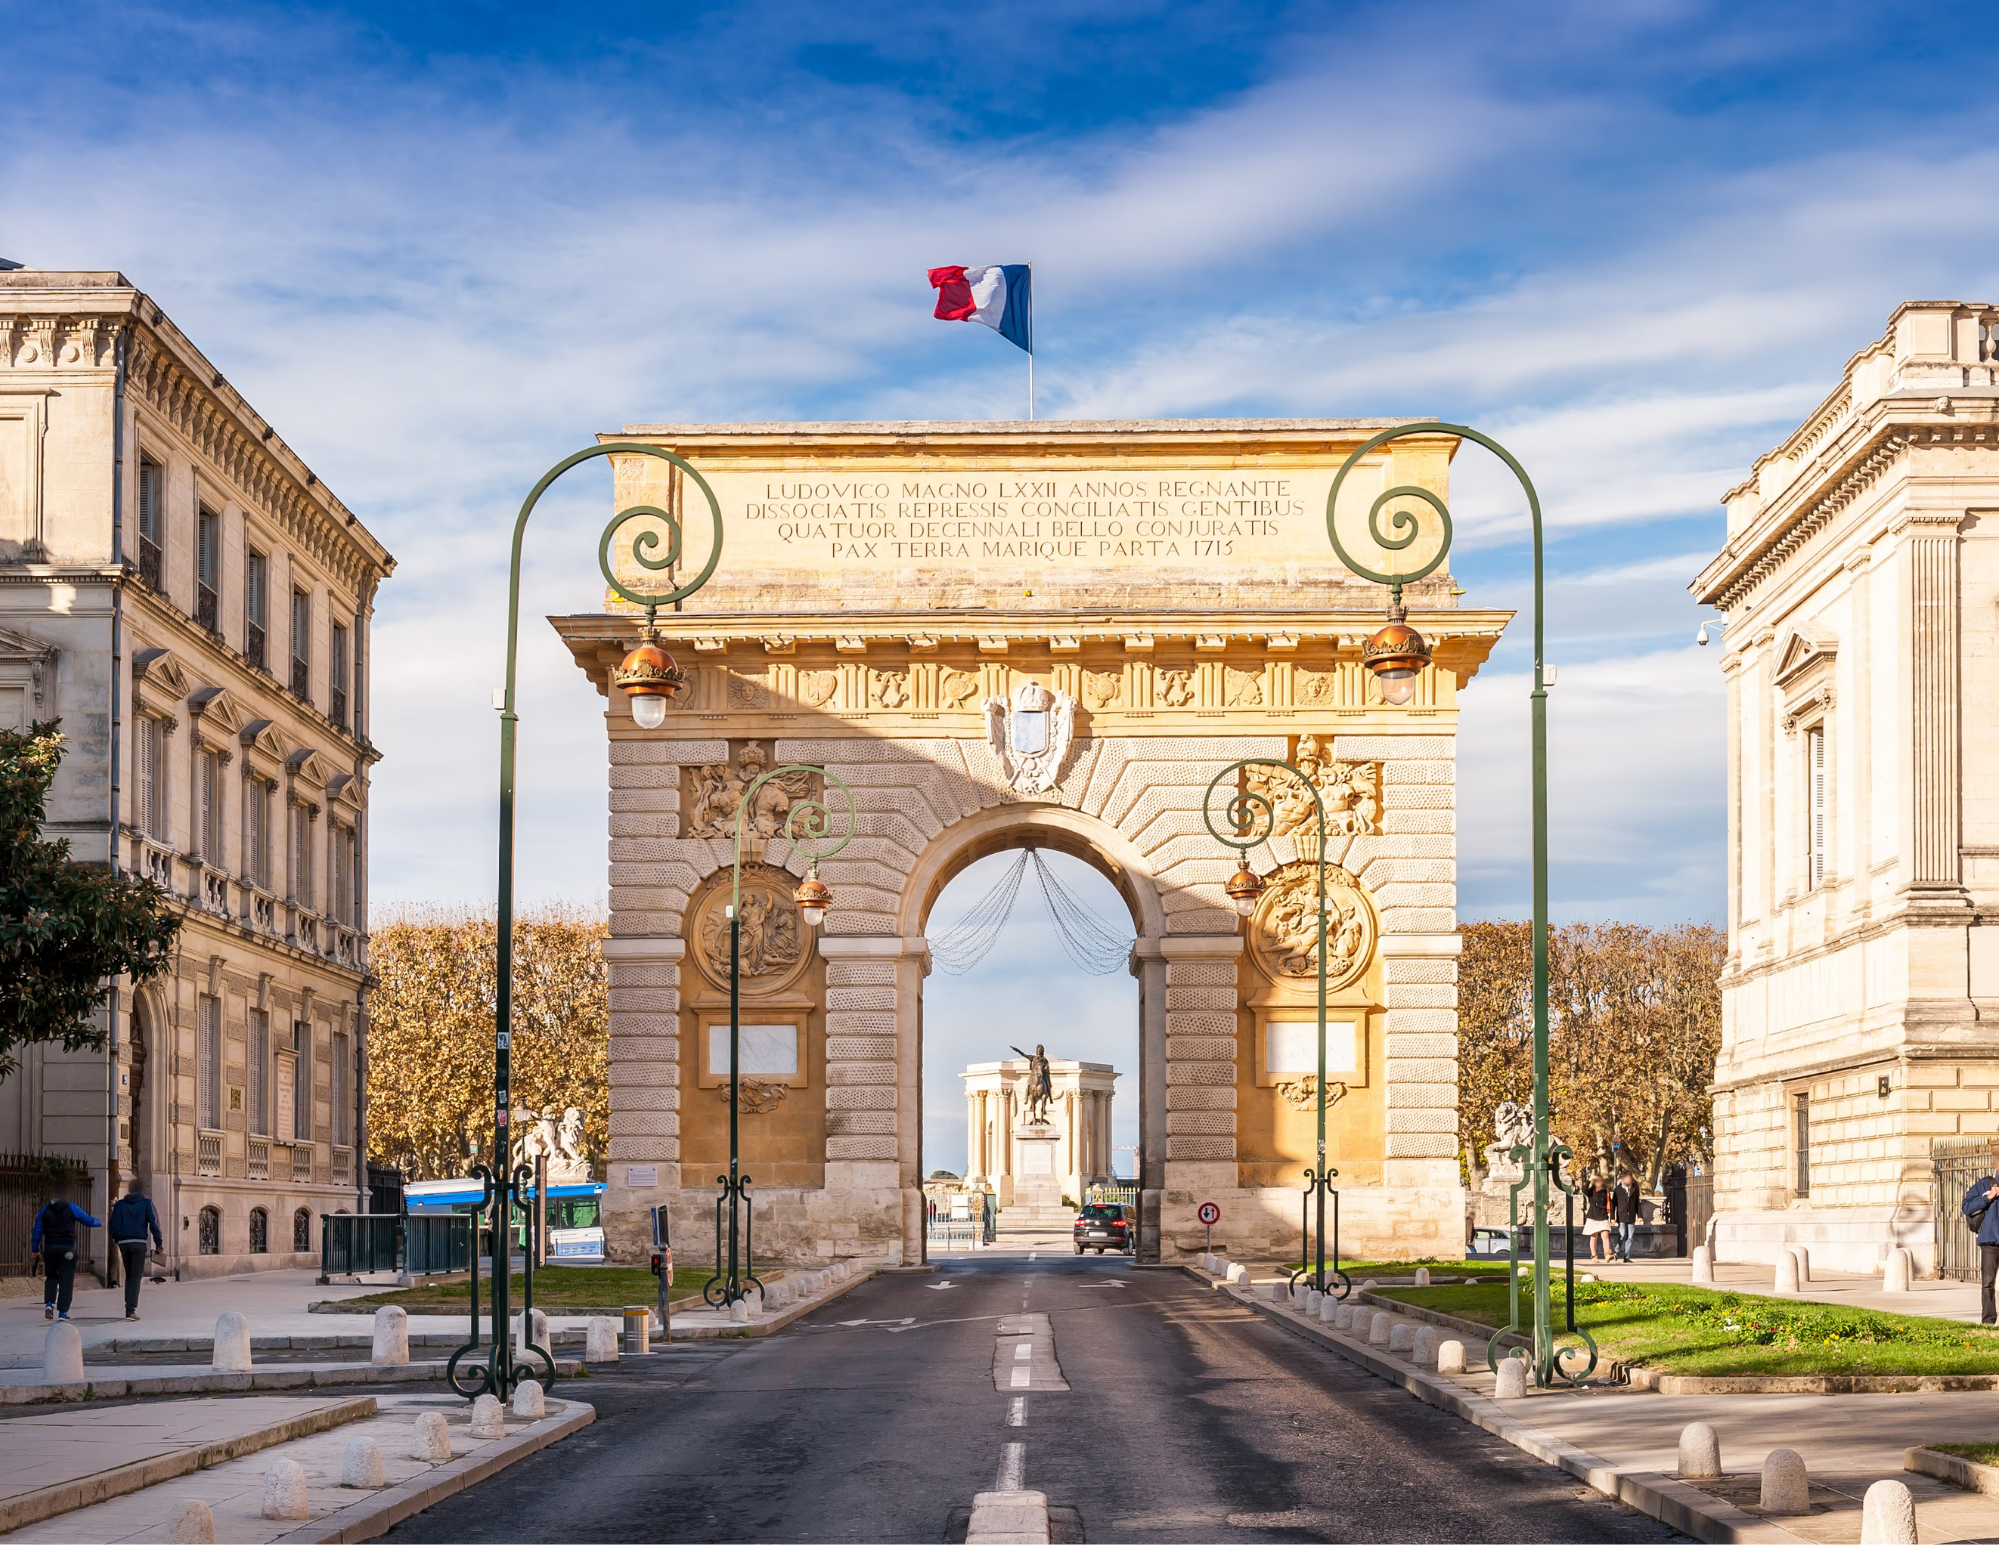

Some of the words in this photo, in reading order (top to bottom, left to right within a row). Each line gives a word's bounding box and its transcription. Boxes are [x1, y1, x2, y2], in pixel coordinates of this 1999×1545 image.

[767, 484, 890, 500] LUDOVICO
[903, 483, 988, 499] MAGNO
[1000, 482, 1057, 499] LXXII
[1069, 482, 1147, 498] ANNOS
[1159, 481, 1291, 498] REGNANTE
[747, 503, 887, 520] DISSOCIATIS
[899, 502, 1008, 519] REPRESSIS
[1022, 502, 1169, 518] CONCILIATIS
[1182, 500, 1304, 517] GENTIBUS
[778, 523, 898, 544] QUATUOR
[910, 522, 1041, 539] DECENNALI
[1053, 521, 1124, 538] BELLO
[1136, 520, 1279, 539] CONJURATIS
[832, 543, 878, 559] PAX
[891, 542, 970, 559] TERRA
[983, 541, 1087, 562] MARIQUE
[1100, 541, 1181, 557] PARTA
[1195, 540, 1234, 557] 1715
